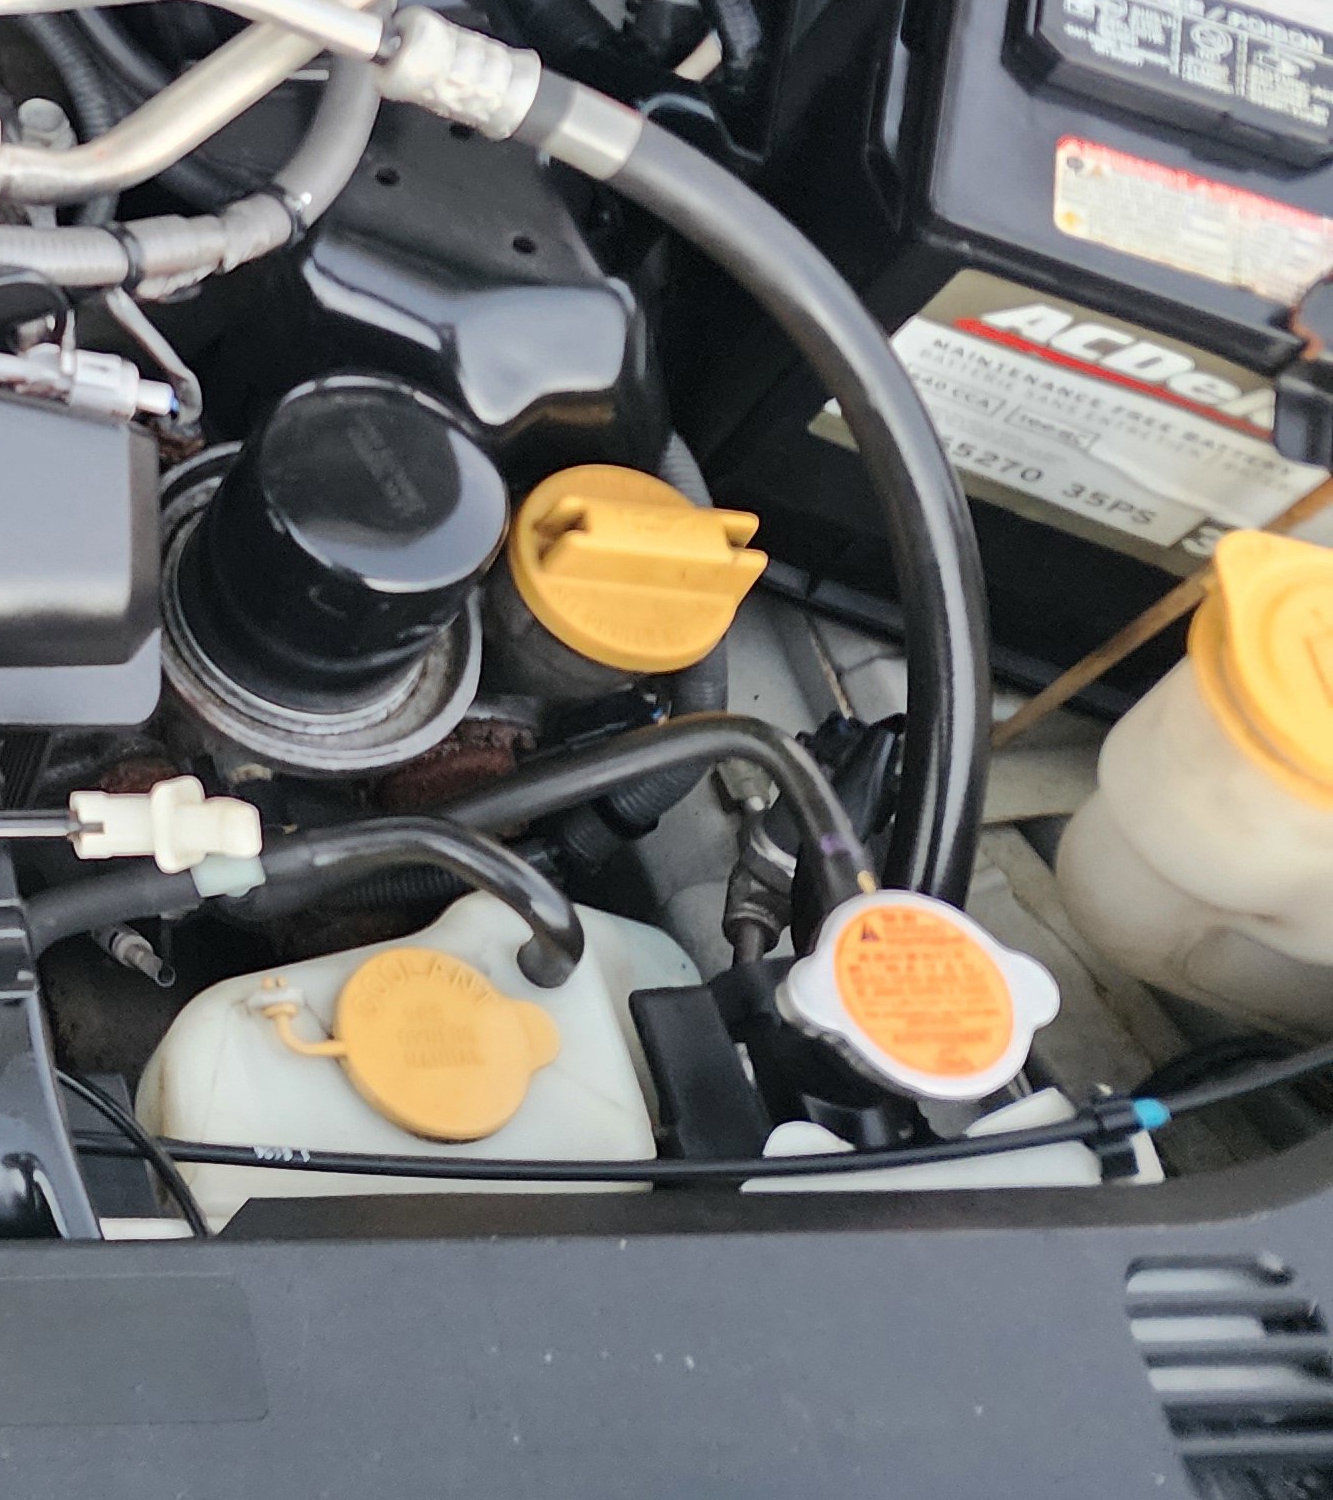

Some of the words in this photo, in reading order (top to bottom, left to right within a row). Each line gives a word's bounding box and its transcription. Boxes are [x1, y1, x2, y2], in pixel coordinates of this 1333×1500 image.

[1227, 10, 1324, 55] POISON
[933, 338, 1101, 409] MAINTENANCE
[979, 303, 1276, 431] ACDel
[1062, 481, 1157, 526] 35PS
